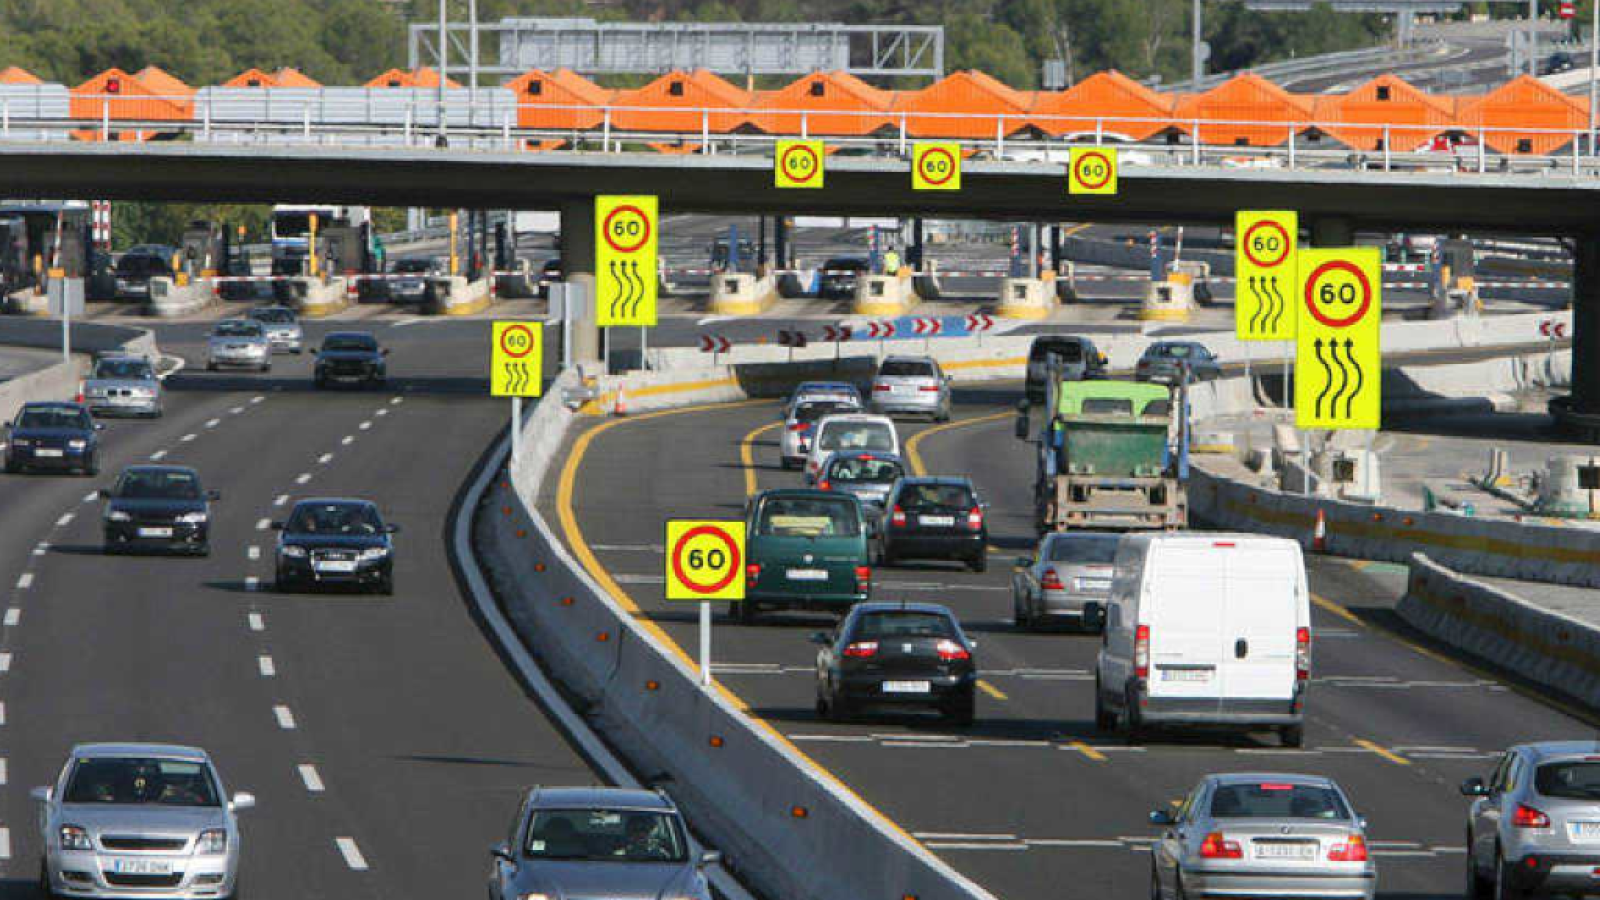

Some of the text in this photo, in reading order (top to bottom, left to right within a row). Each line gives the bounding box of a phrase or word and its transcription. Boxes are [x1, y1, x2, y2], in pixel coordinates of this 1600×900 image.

[789, 158, 810, 169] 60
[926, 161, 948, 172] 60
[1083, 164, 1103, 176] 60
[613, 220, 640, 237] 60
[1253, 236, 1279, 252] 60
[1319, 283, 1356, 305] 60
[507, 336, 525, 347] 60
[688, 549, 726, 570] 60
